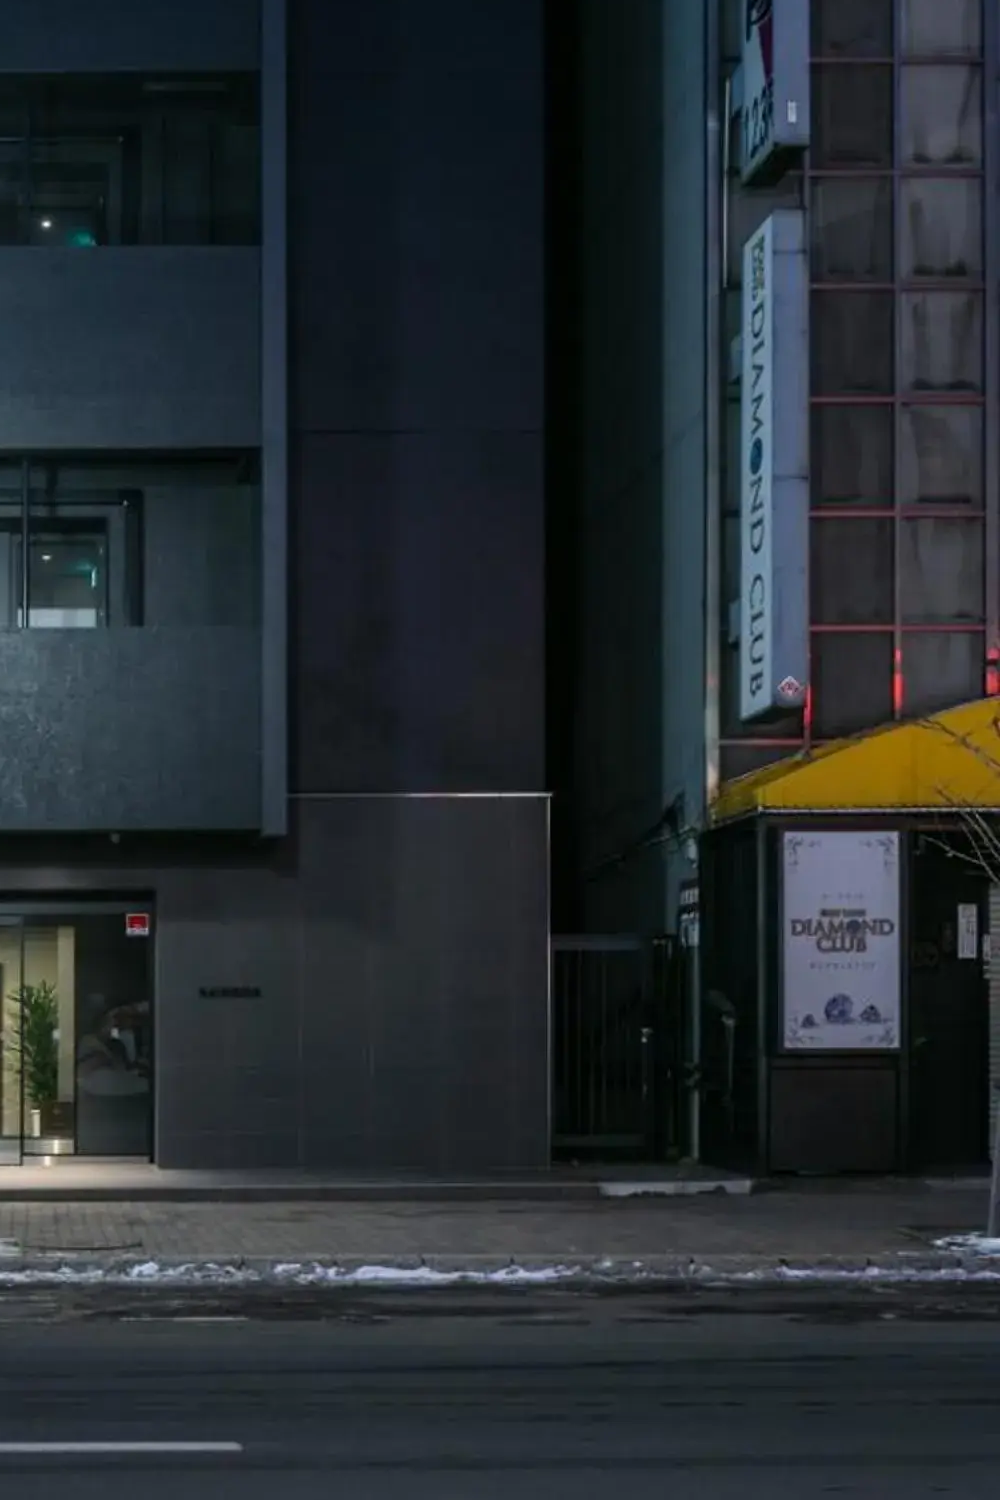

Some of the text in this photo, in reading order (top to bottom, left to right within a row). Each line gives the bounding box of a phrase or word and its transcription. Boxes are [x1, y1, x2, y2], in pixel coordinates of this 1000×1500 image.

[748, 304, 766, 556] DIAMOND
[748, 572, 766, 699] CLUB
[790, 917, 895, 937] DIAMOND
[816, 934, 867, 954] CLUB
